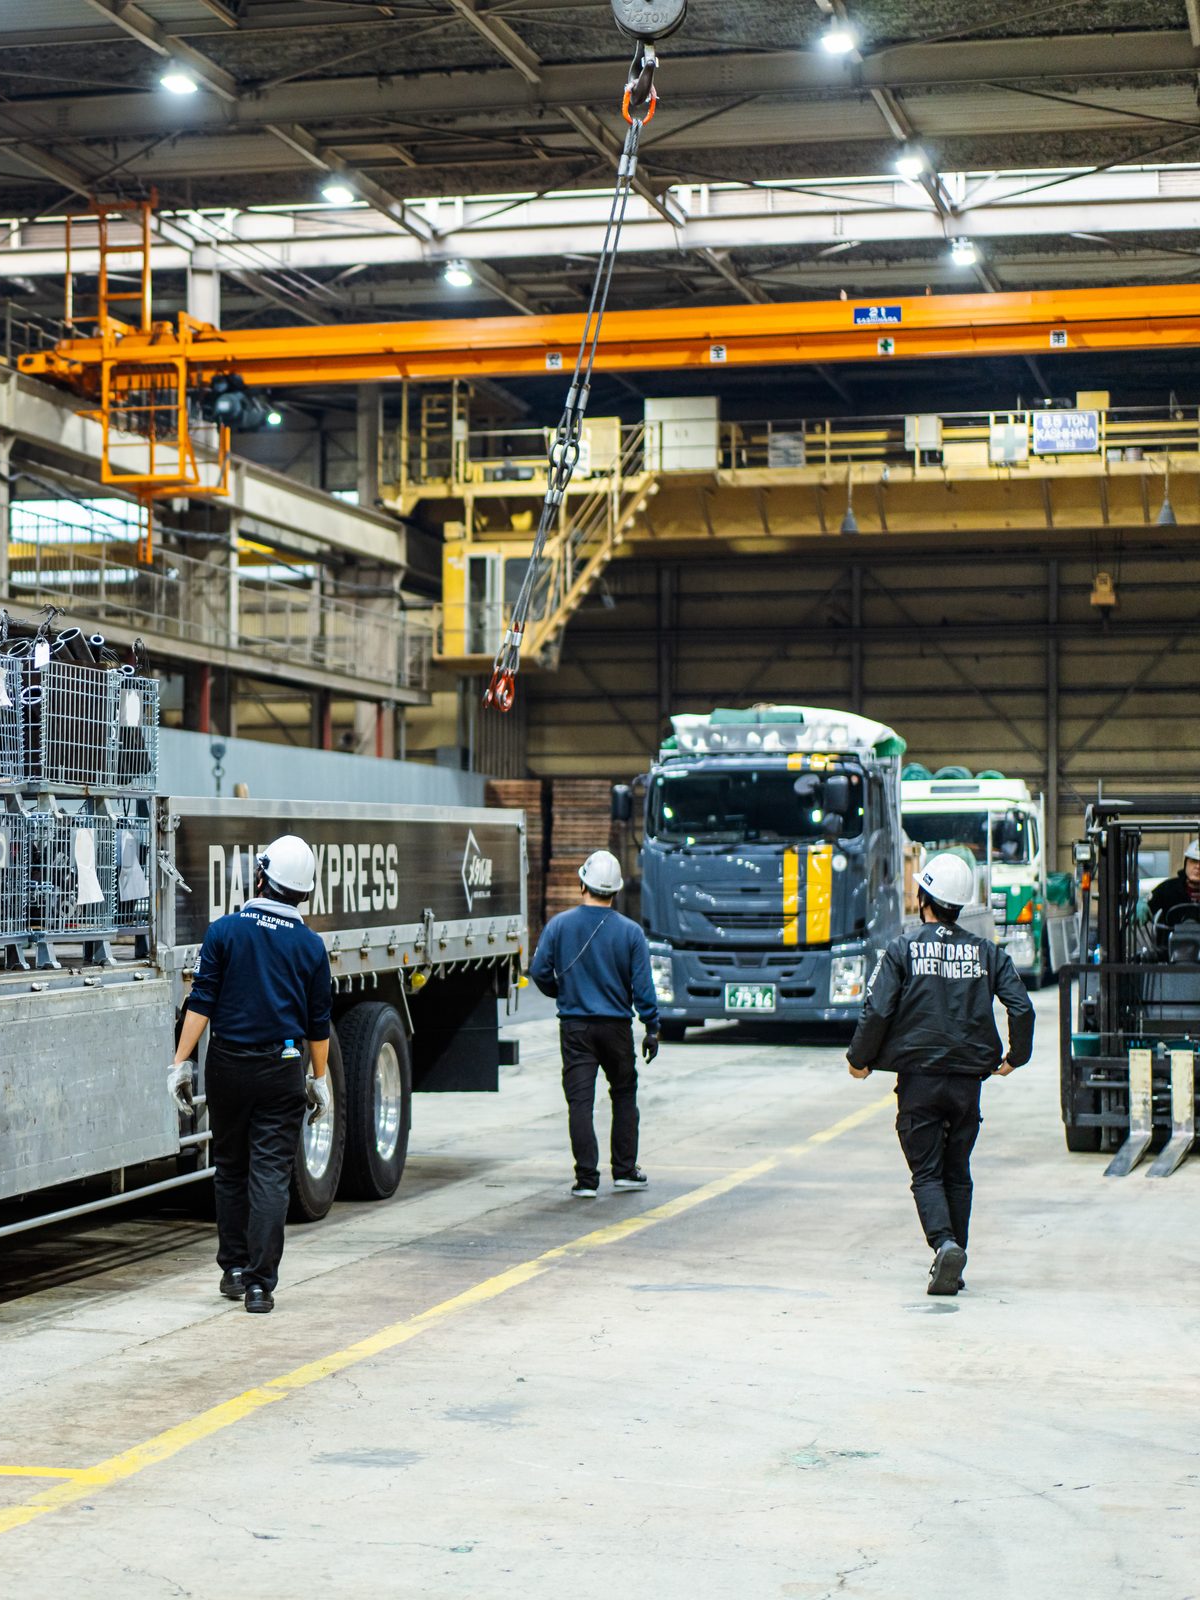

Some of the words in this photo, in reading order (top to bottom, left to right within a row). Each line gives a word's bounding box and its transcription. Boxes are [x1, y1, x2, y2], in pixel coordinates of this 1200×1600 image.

[1065, 414, 1089, 428] TON
[1036, 426, 1095, 441] KASHIHARA
[208, 844, 267, 923] DAI
[300, 843, 399, 915] XPRESS
[240, 912, 260, 920] DAIEI
[261, 914, 294, 929] EXPRESS
[912, 958, 960, 979] MEETING
